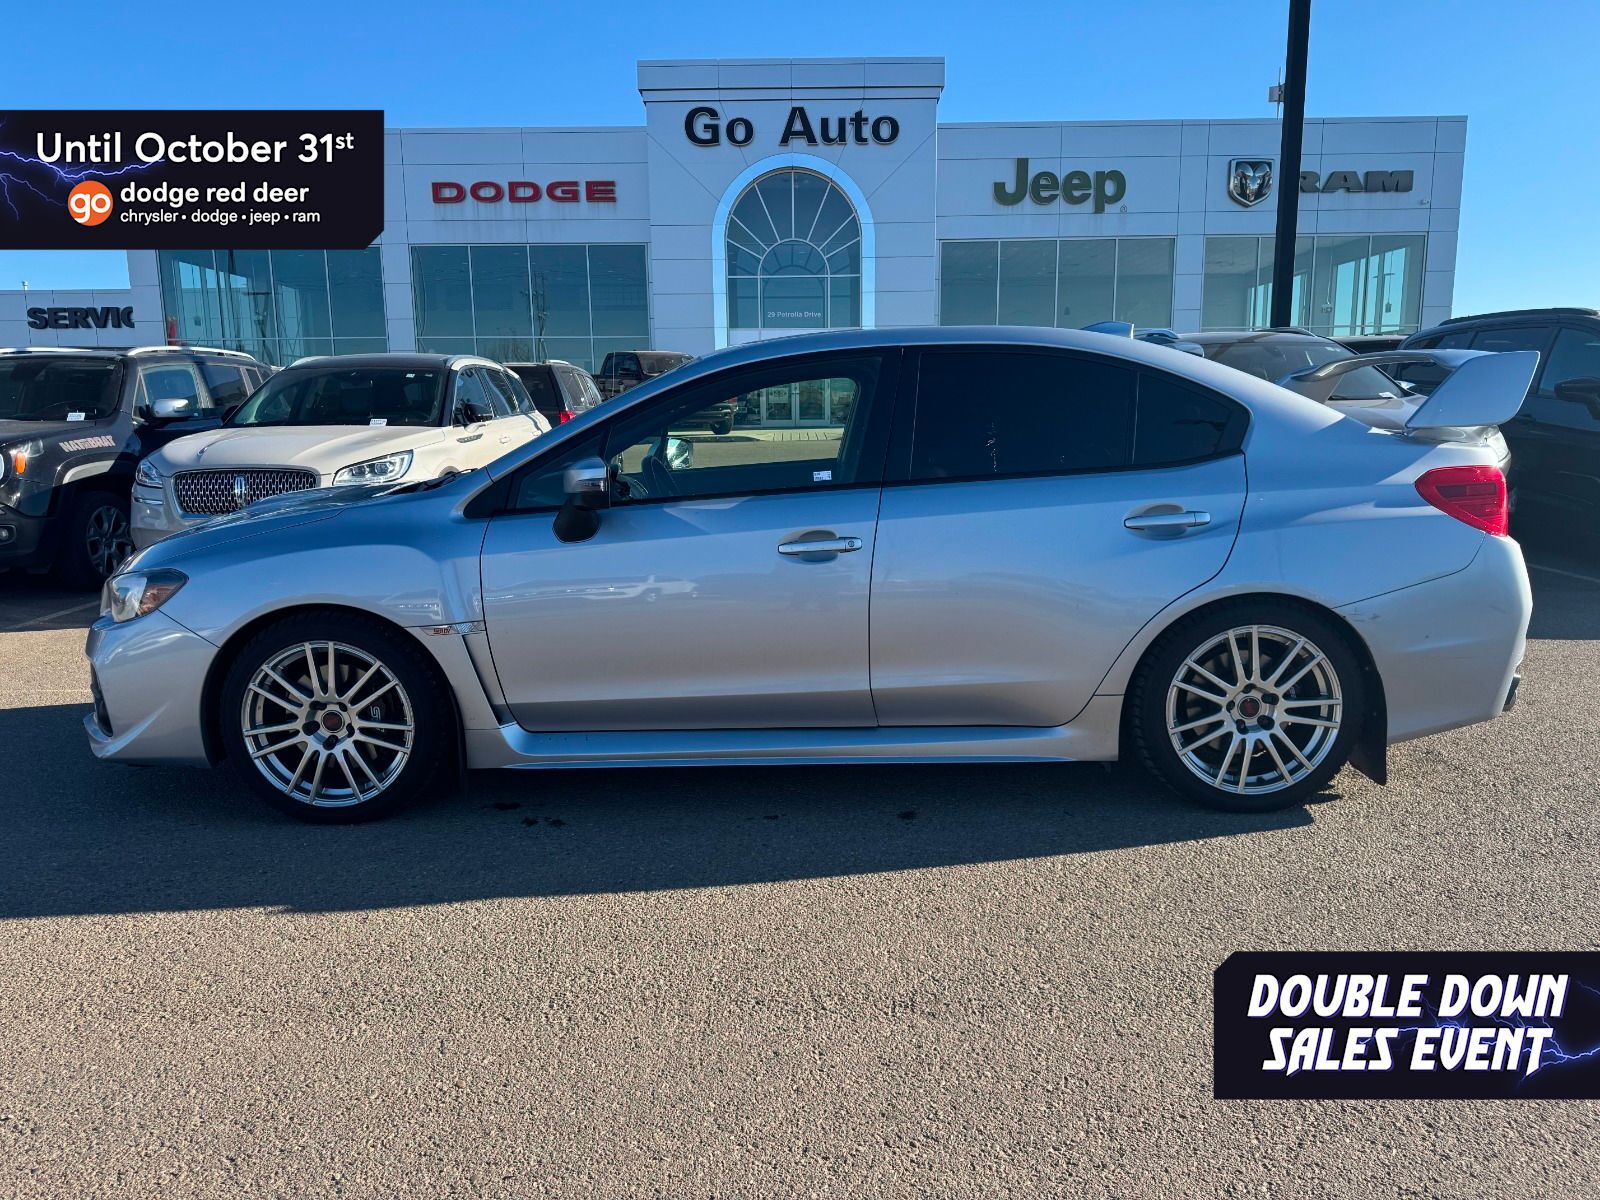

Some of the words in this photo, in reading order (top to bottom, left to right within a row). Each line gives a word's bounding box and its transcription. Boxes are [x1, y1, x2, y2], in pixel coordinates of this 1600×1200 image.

[684, 106, 754, 147] Go
[780, 106, 900, 146] Auto
[431, 180, 617, 204] DODGE
[993, 157, 1127, 214] Jeep
[1299, 170, 1414, 193] RAM
